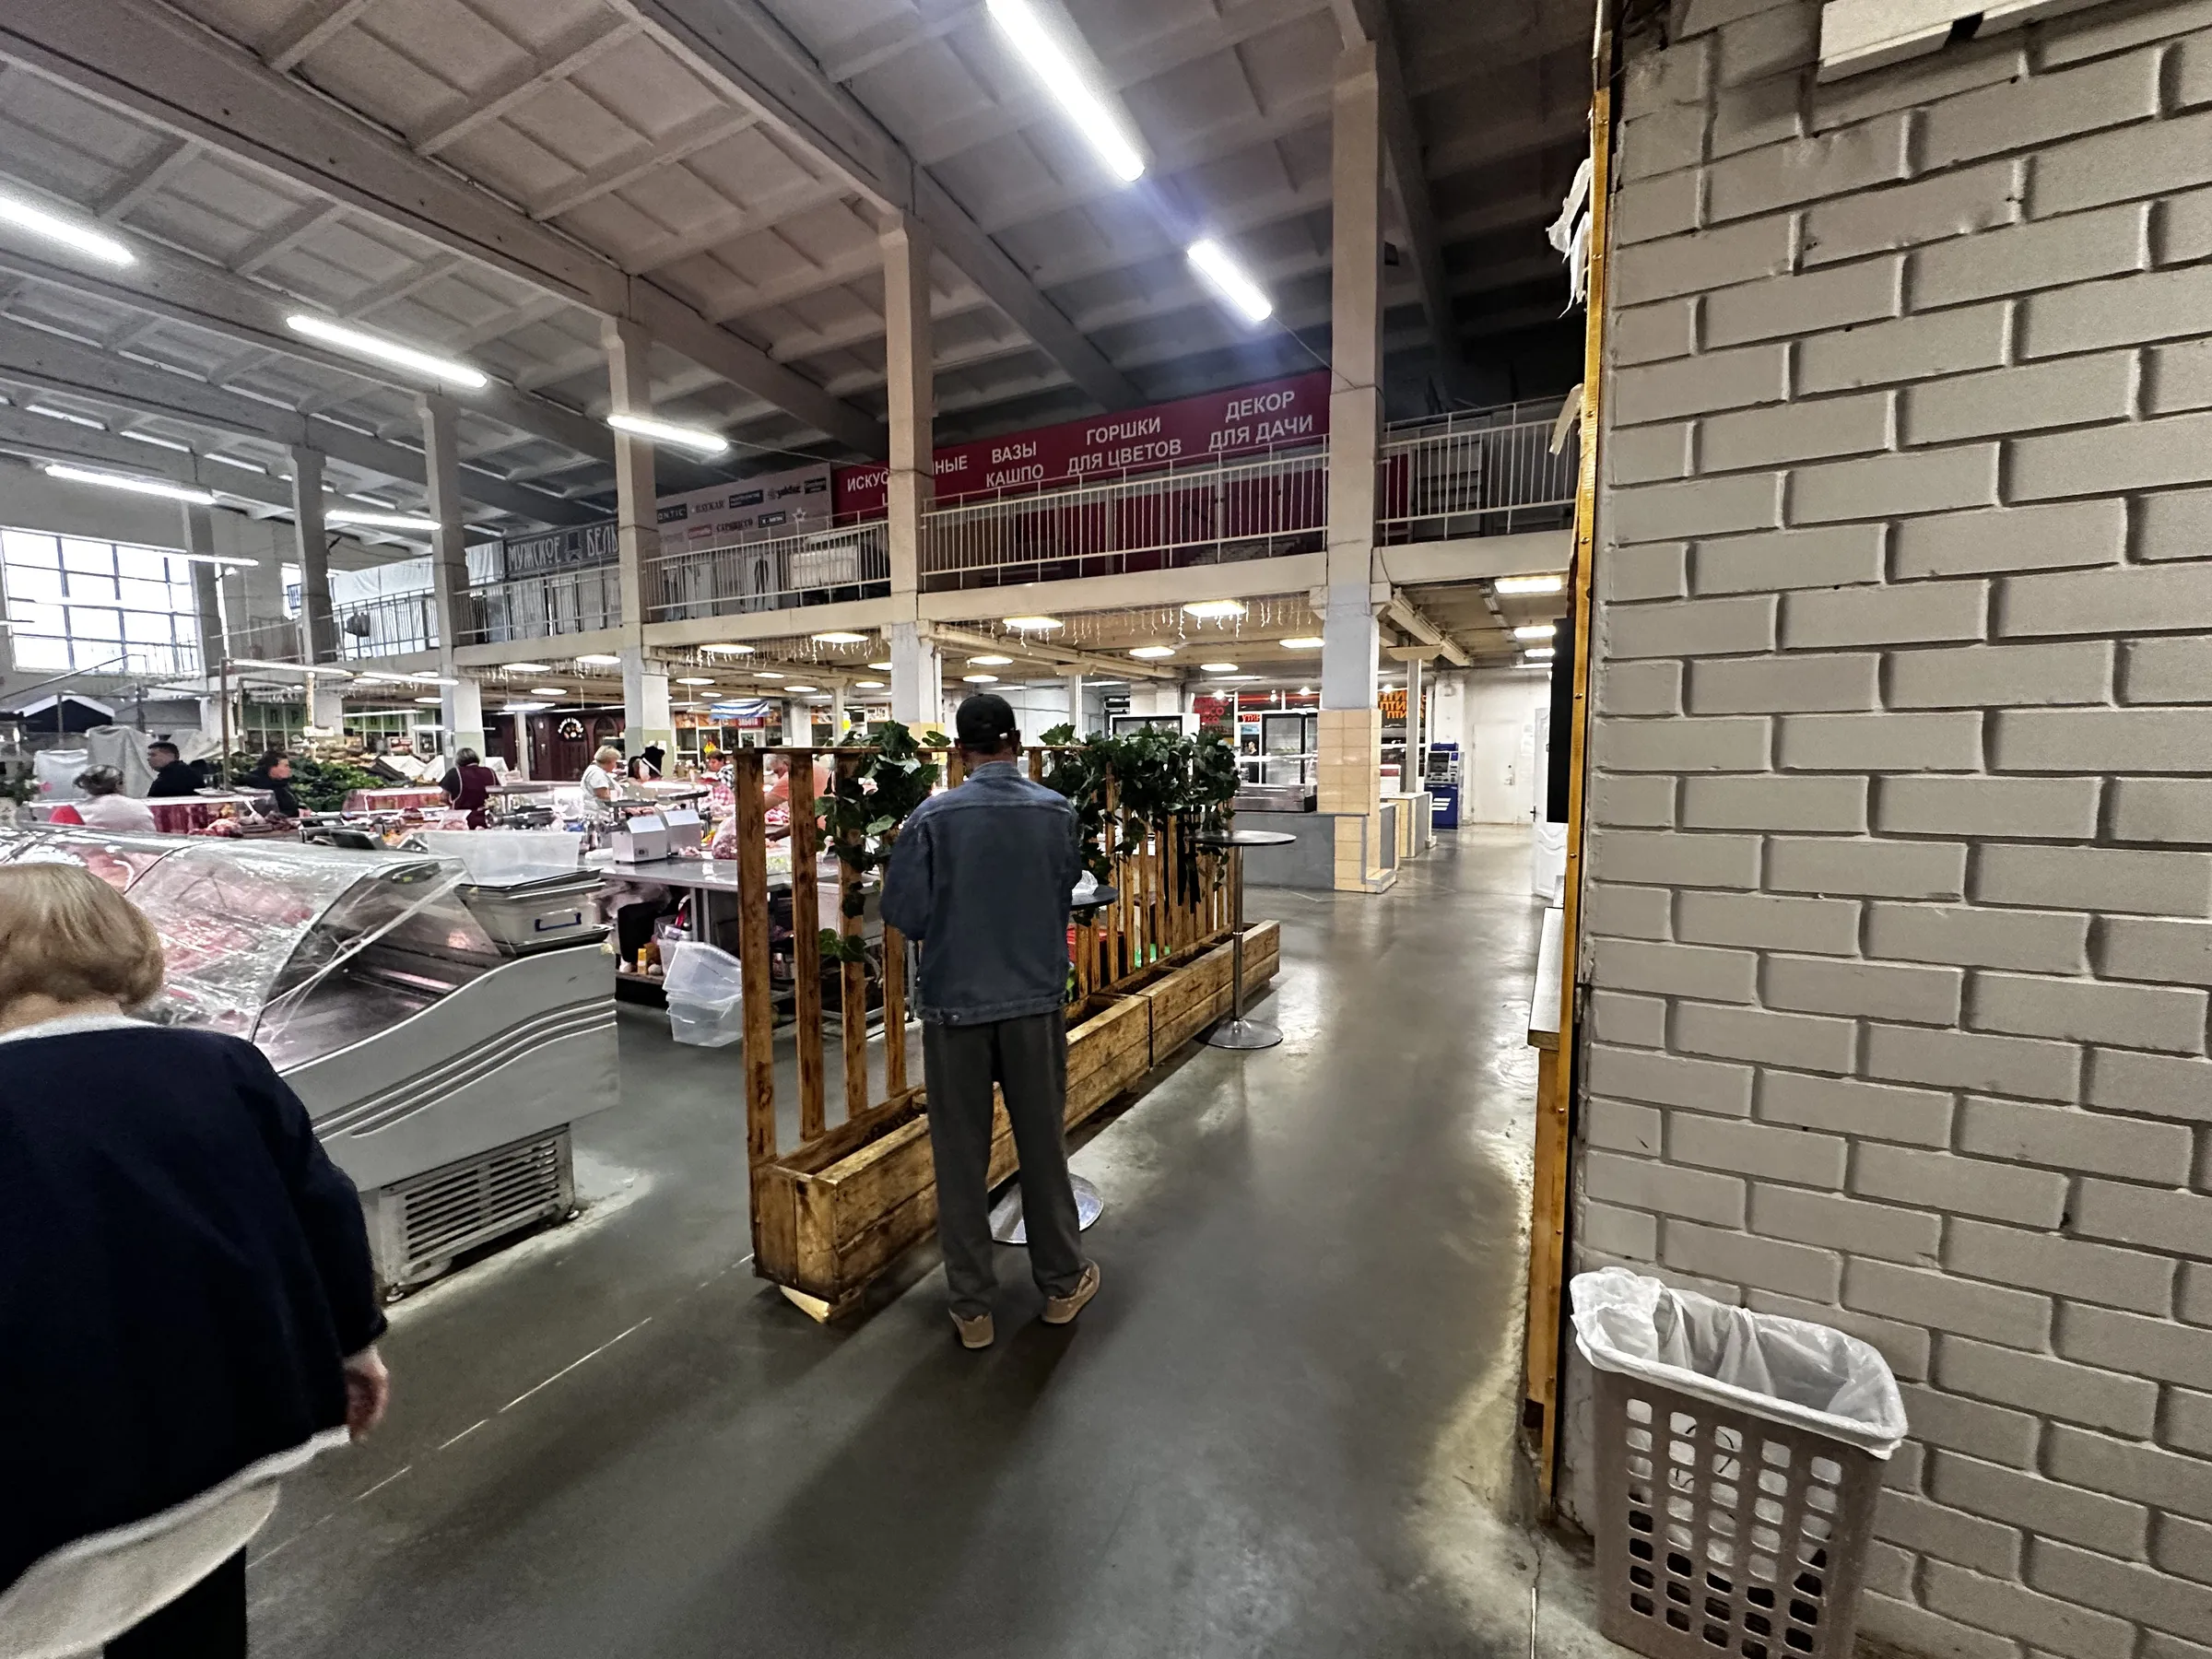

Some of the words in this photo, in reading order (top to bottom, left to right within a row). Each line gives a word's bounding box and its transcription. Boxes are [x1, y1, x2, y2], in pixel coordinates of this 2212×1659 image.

[1225, 391, 1295, 423] ДЕКОР
[1086, 417, 1161, 446] ГОРШКИ
[1208, 426, 1251, 453] ДЛЯ
[1255, 414, 1313, 444] ДАЧИ
[992, 441, 1038, 465] ВАЗЫ
[1066, 453, 1103, 477] ДЛЯ
[1108, 438, 1182, 468] ЦВЕТОВ
[985, 464, 1044, 488] КАШПО
[507, 535, 561, 571] МУЖСКОЕ
[586, 524, 619, 558] БЕЛЬ
